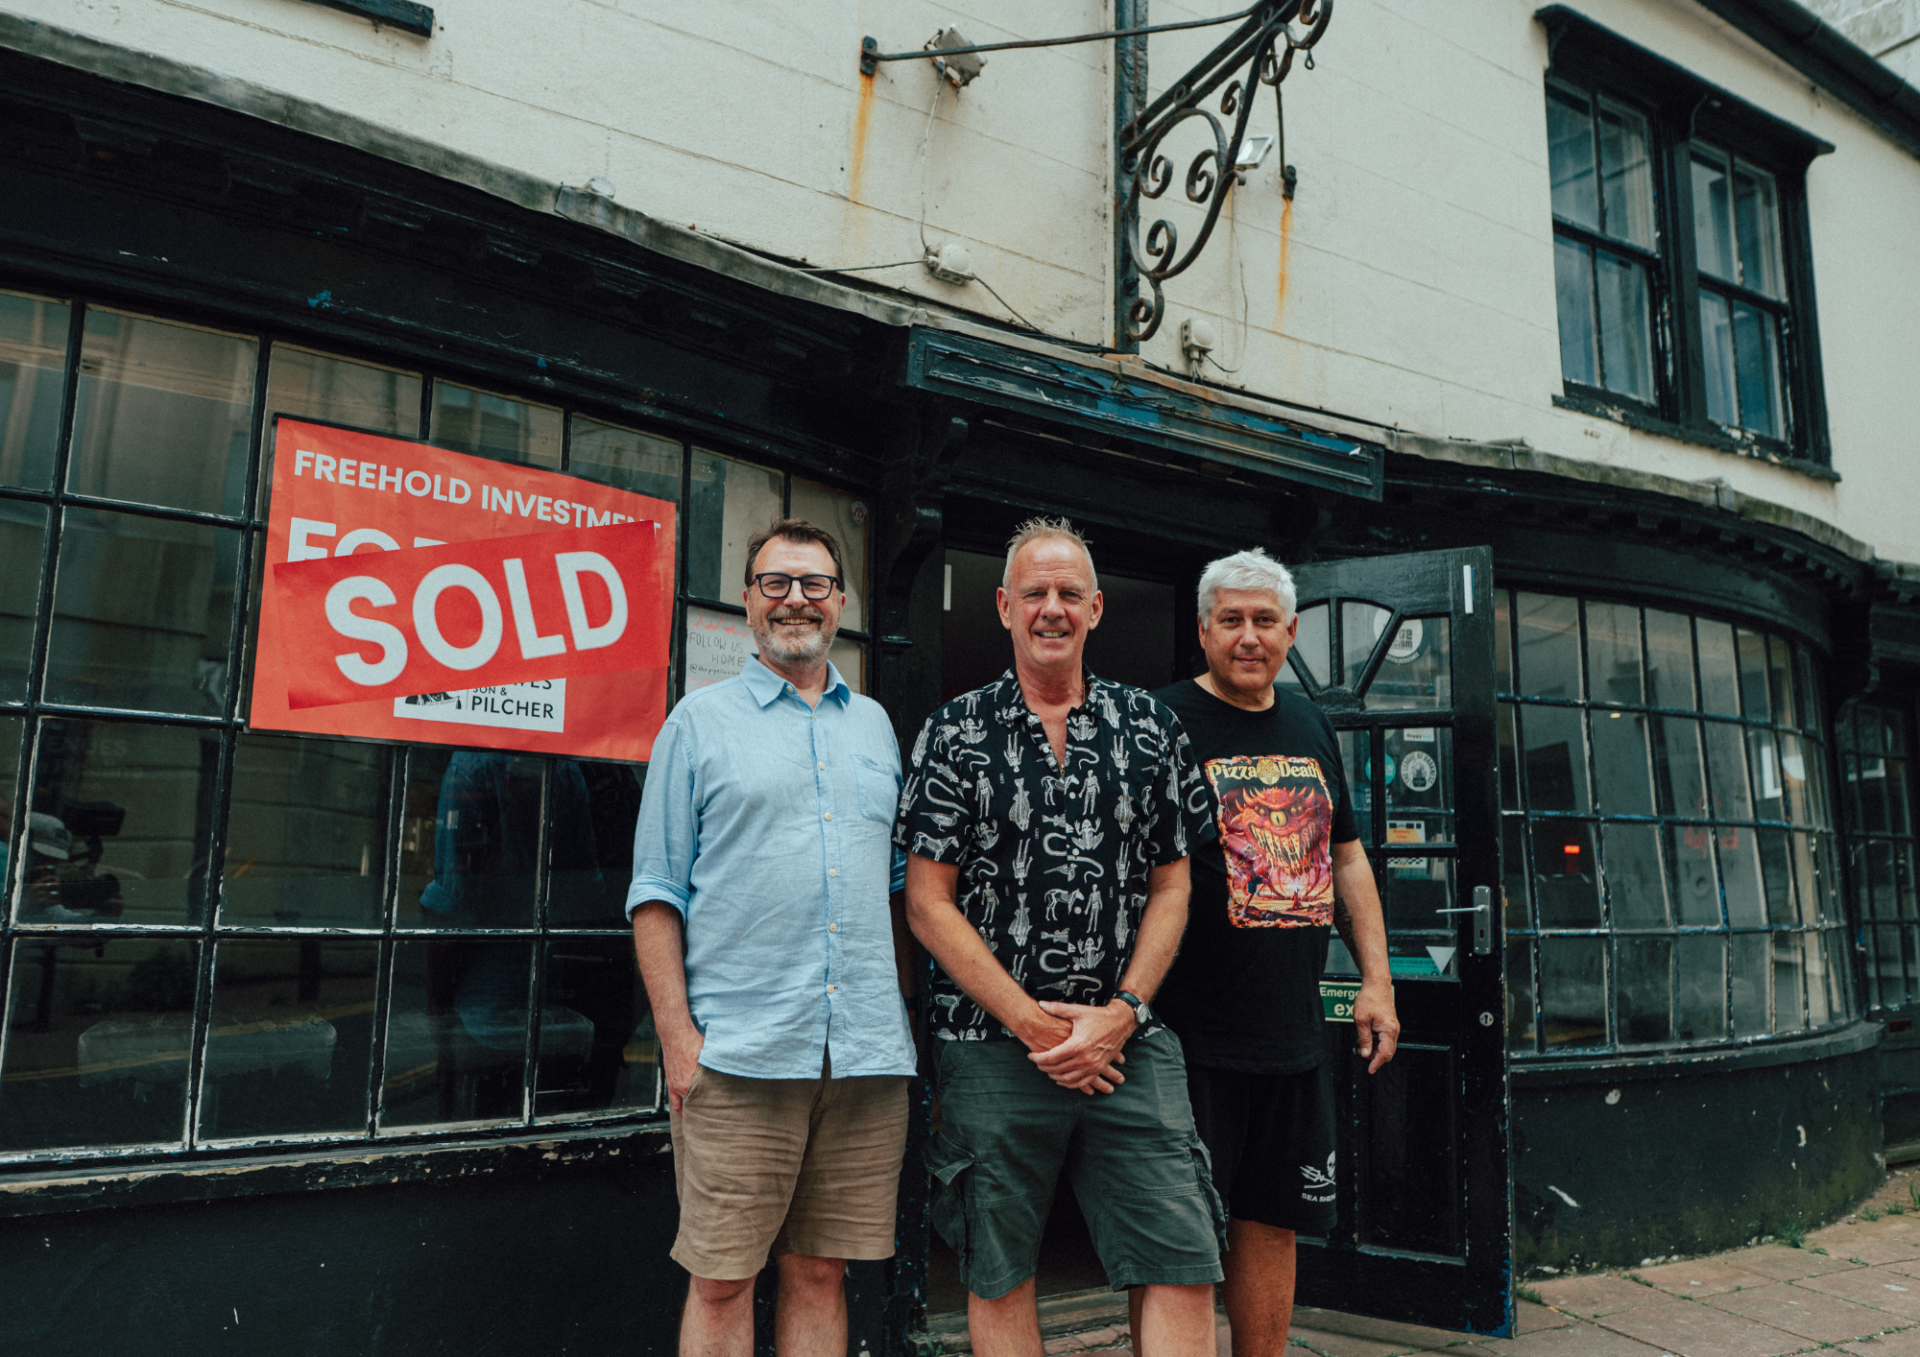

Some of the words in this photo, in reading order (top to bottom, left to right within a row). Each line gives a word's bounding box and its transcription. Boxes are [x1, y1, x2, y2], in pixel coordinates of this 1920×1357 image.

[294, 449, 471, 505] FREEHOLD
[481, 484, 662, 538] INVESTM
[325, 551, 628, 687] SOLD
[688, 631, 727, 650] FOLLOW
[731, 641, 743, 654] US
[711, 653, 746, 667] HOME
[500, 687, 507, 696] &
[472, 696, 554, 719] PILCHER
[1207, 764, 1258, 781] Pizza
[1278, 760, 1326, 783] Death
[1320, 986, 1360, 1000] Emerg
[1334, 1003, 1354, 1016] ex
[1301, 1192, 1318, 1202] SEA
